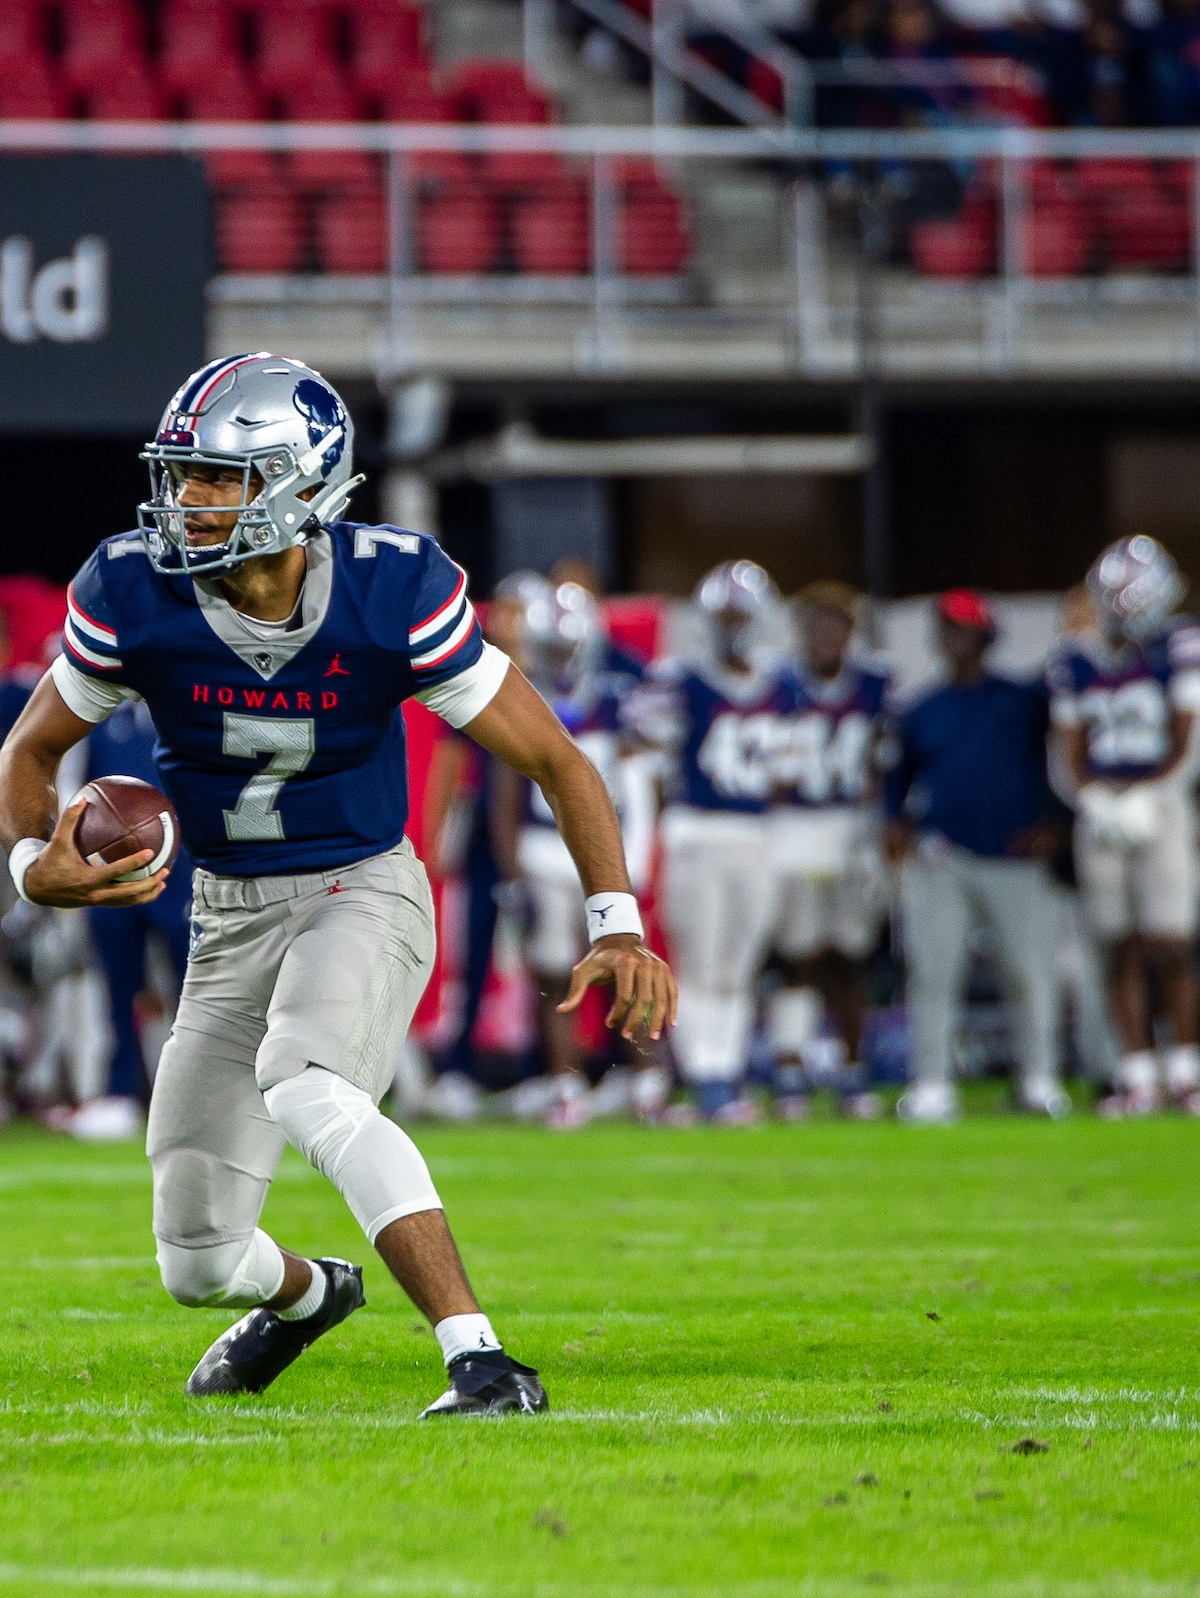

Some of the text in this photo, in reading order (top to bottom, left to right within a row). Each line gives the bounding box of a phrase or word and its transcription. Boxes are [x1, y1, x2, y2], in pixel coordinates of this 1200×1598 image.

[353, 528, 420, 559] 7
[193, 684, 338, 710] HOWARD
[222, 711, 316, 841] 7
